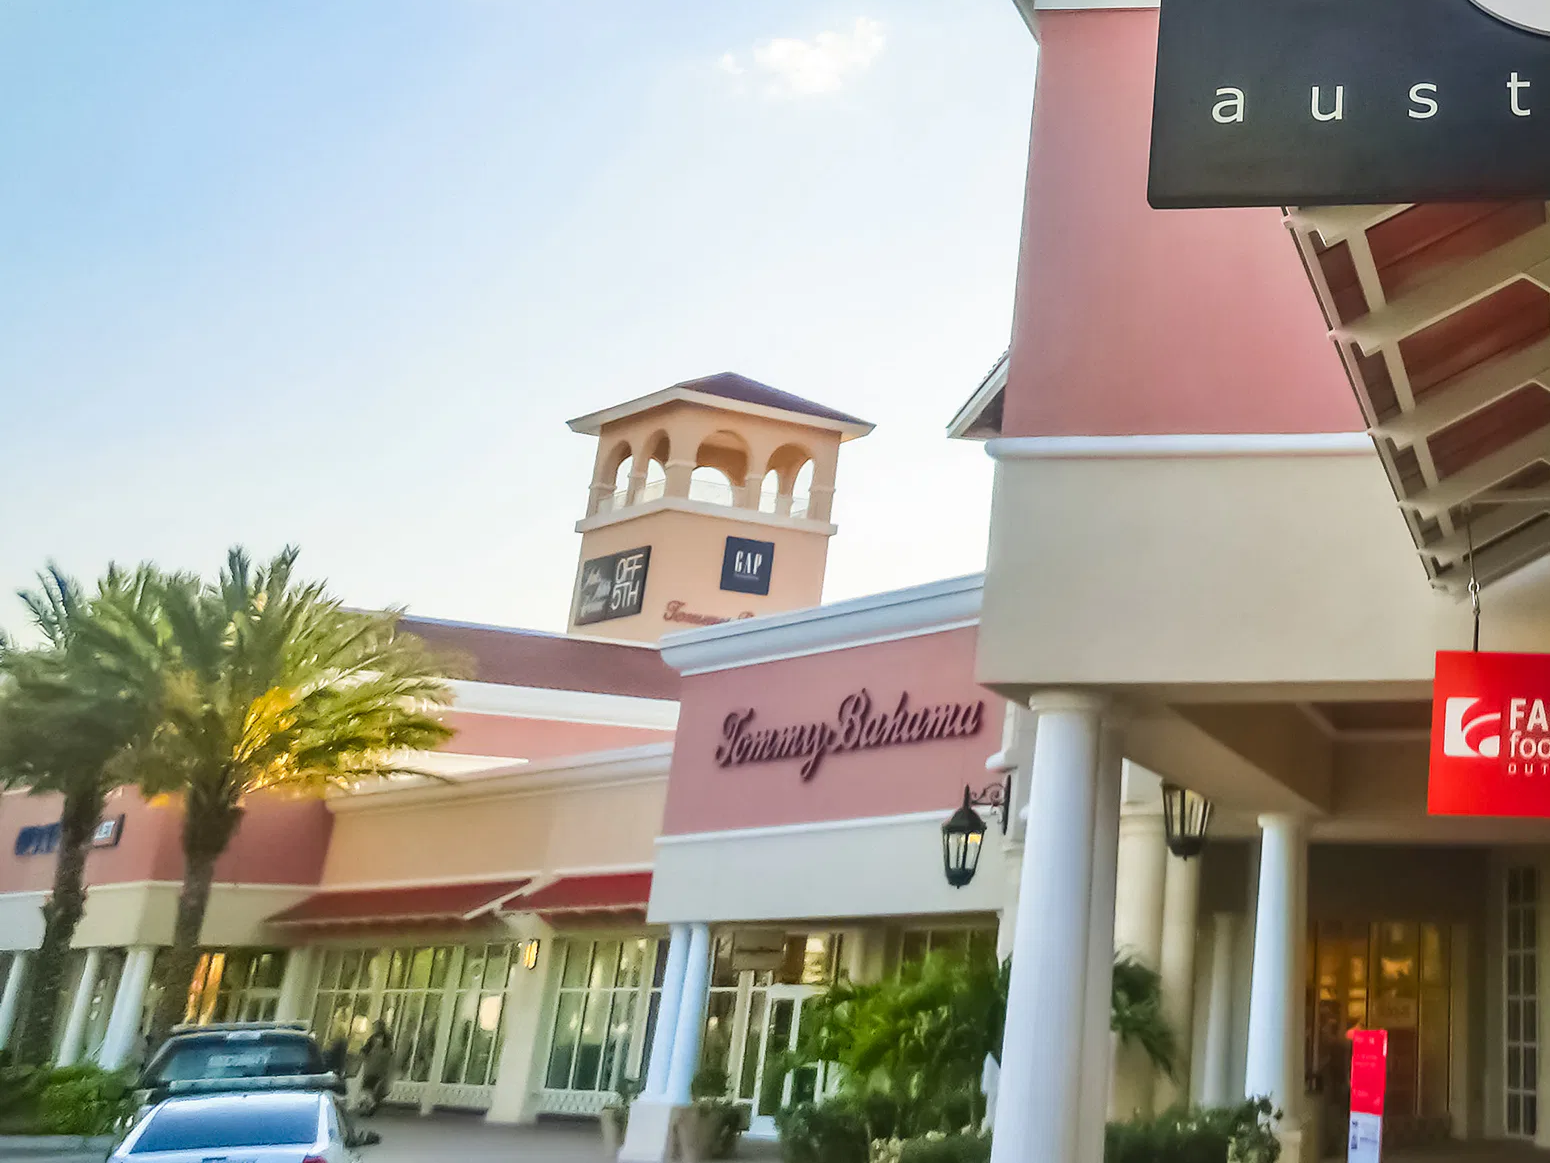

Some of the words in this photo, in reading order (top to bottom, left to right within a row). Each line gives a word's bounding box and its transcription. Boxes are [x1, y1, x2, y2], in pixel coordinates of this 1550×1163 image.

[616, 554, 643, 583] OFF
[734, 551, 762, 574] GAP
[611, 581, 639, 610] 5TH
[715, 707, 832, 783] Tommy
[832, 687, 985, 754] Bahama
